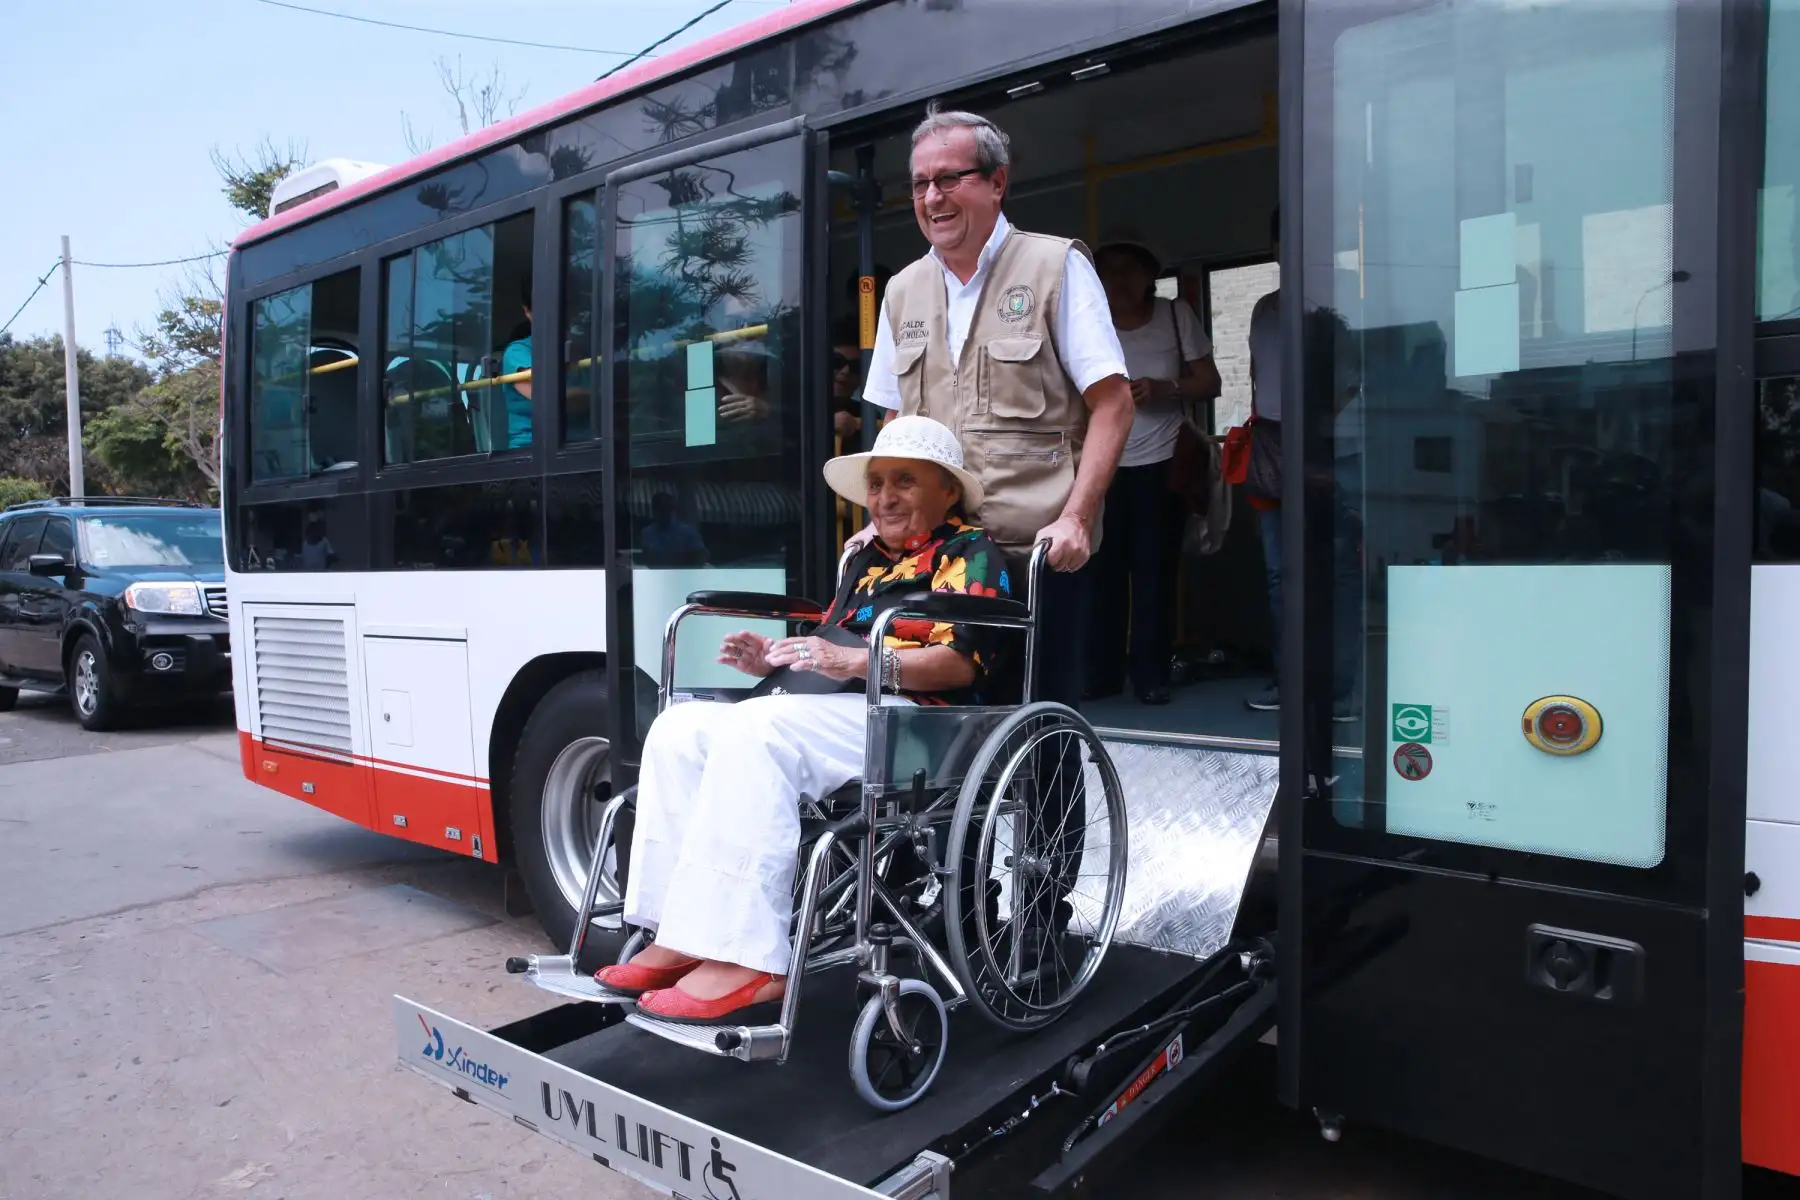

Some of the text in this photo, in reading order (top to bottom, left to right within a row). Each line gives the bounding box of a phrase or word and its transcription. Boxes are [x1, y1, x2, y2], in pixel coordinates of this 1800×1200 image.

[446, 1046, 508, 1089] Xinder
[541, 1080, 695, 1181] UVL LIFT
